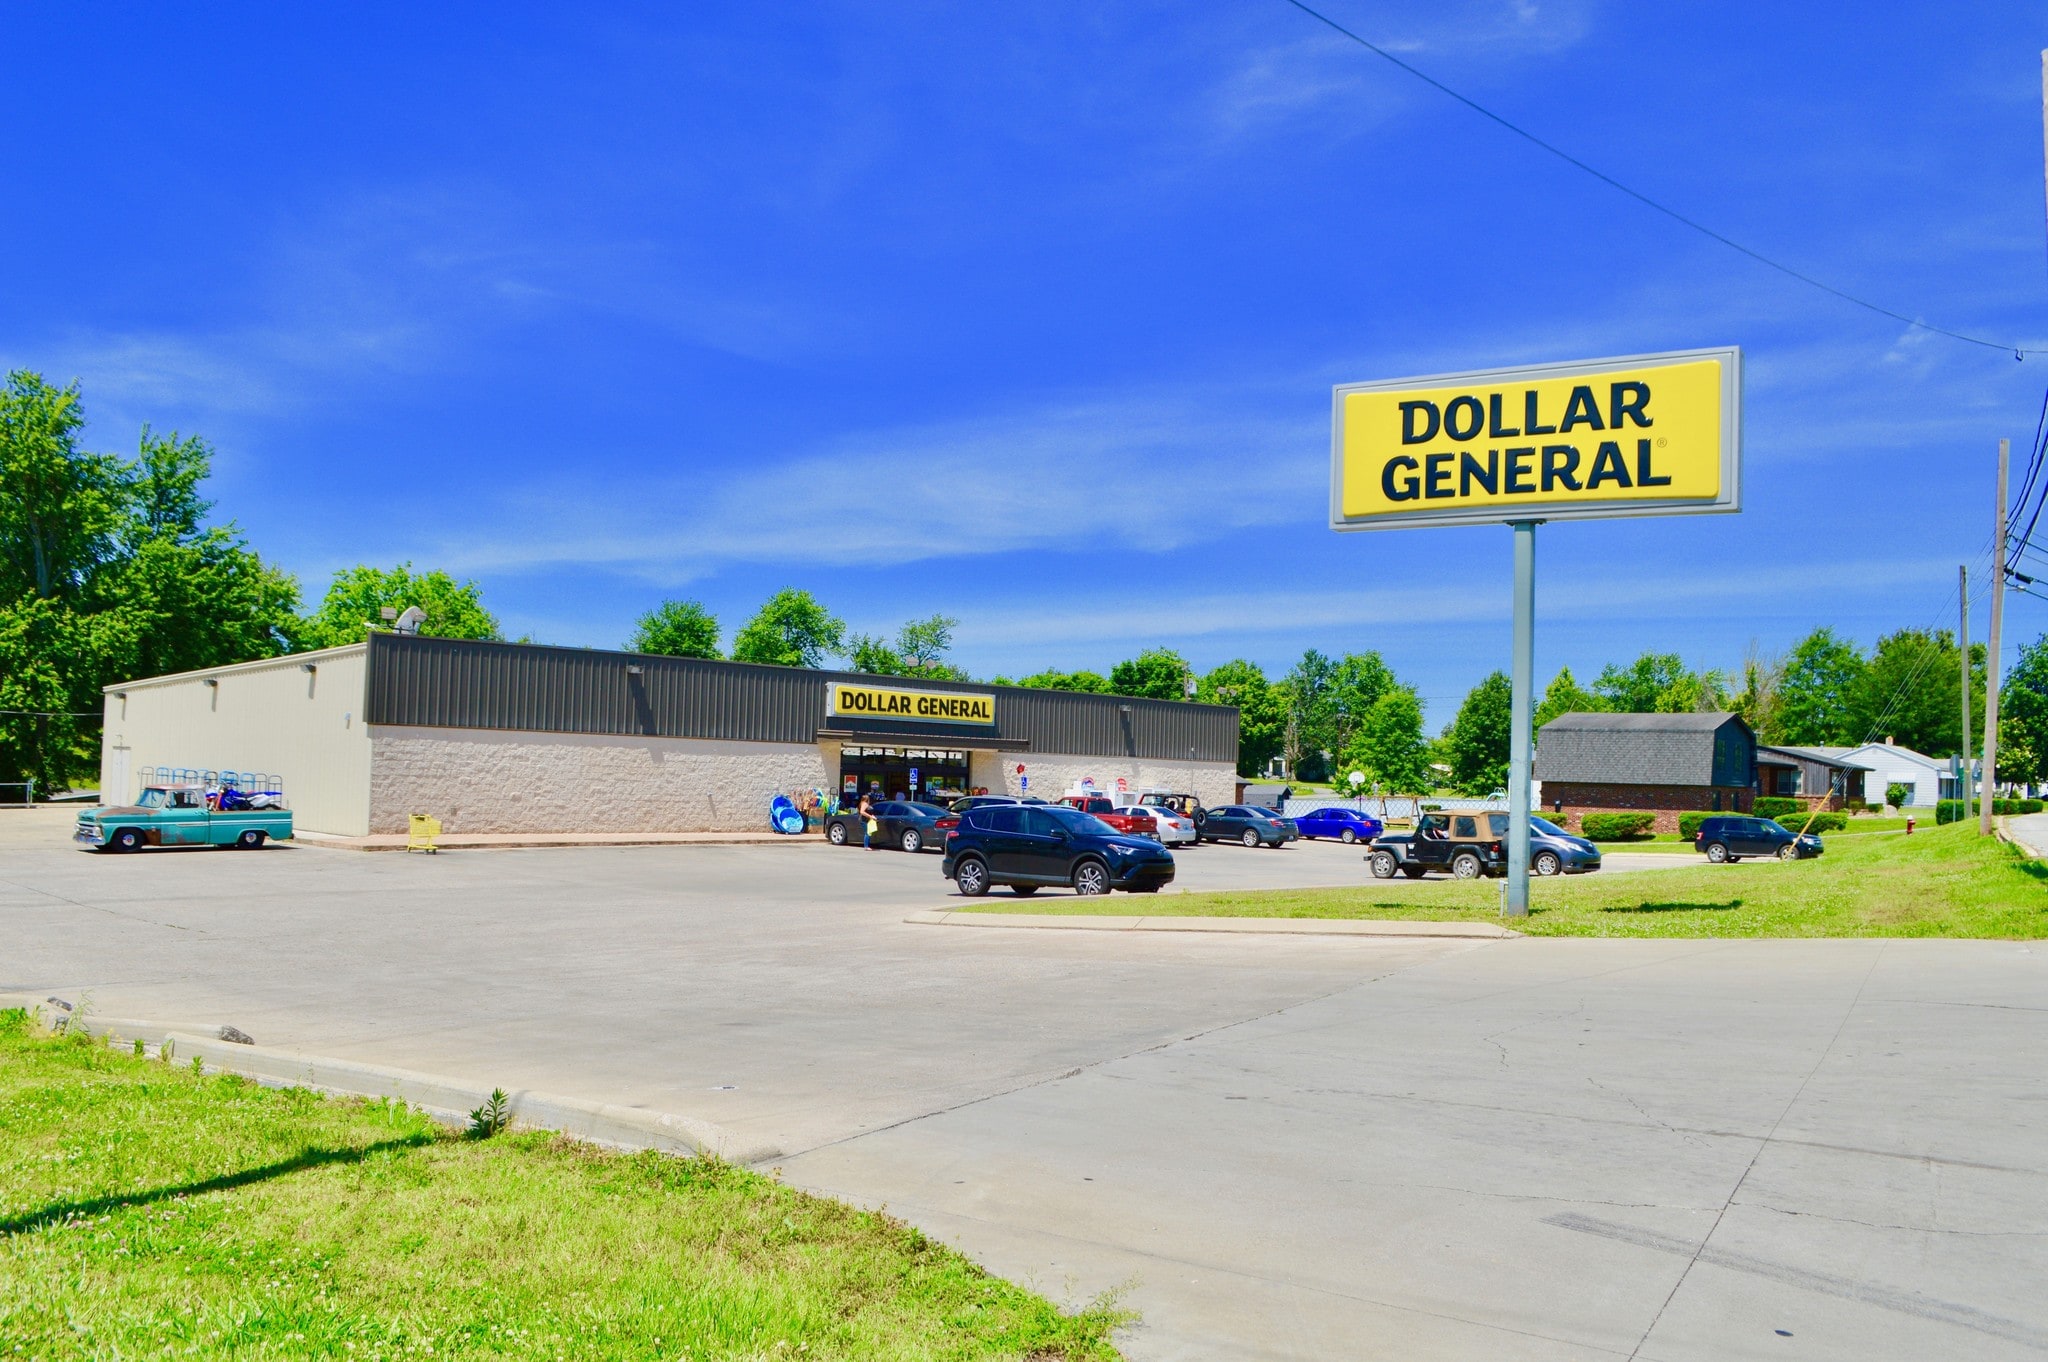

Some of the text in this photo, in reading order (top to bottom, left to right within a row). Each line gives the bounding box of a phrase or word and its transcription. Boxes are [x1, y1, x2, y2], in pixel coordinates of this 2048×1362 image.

[1398, 381, 1654, 446] DOLLAR
[1381, 438, 1672, 502] GENERAL
[841, 691, 990, 718] DOLLAR GENERAL
